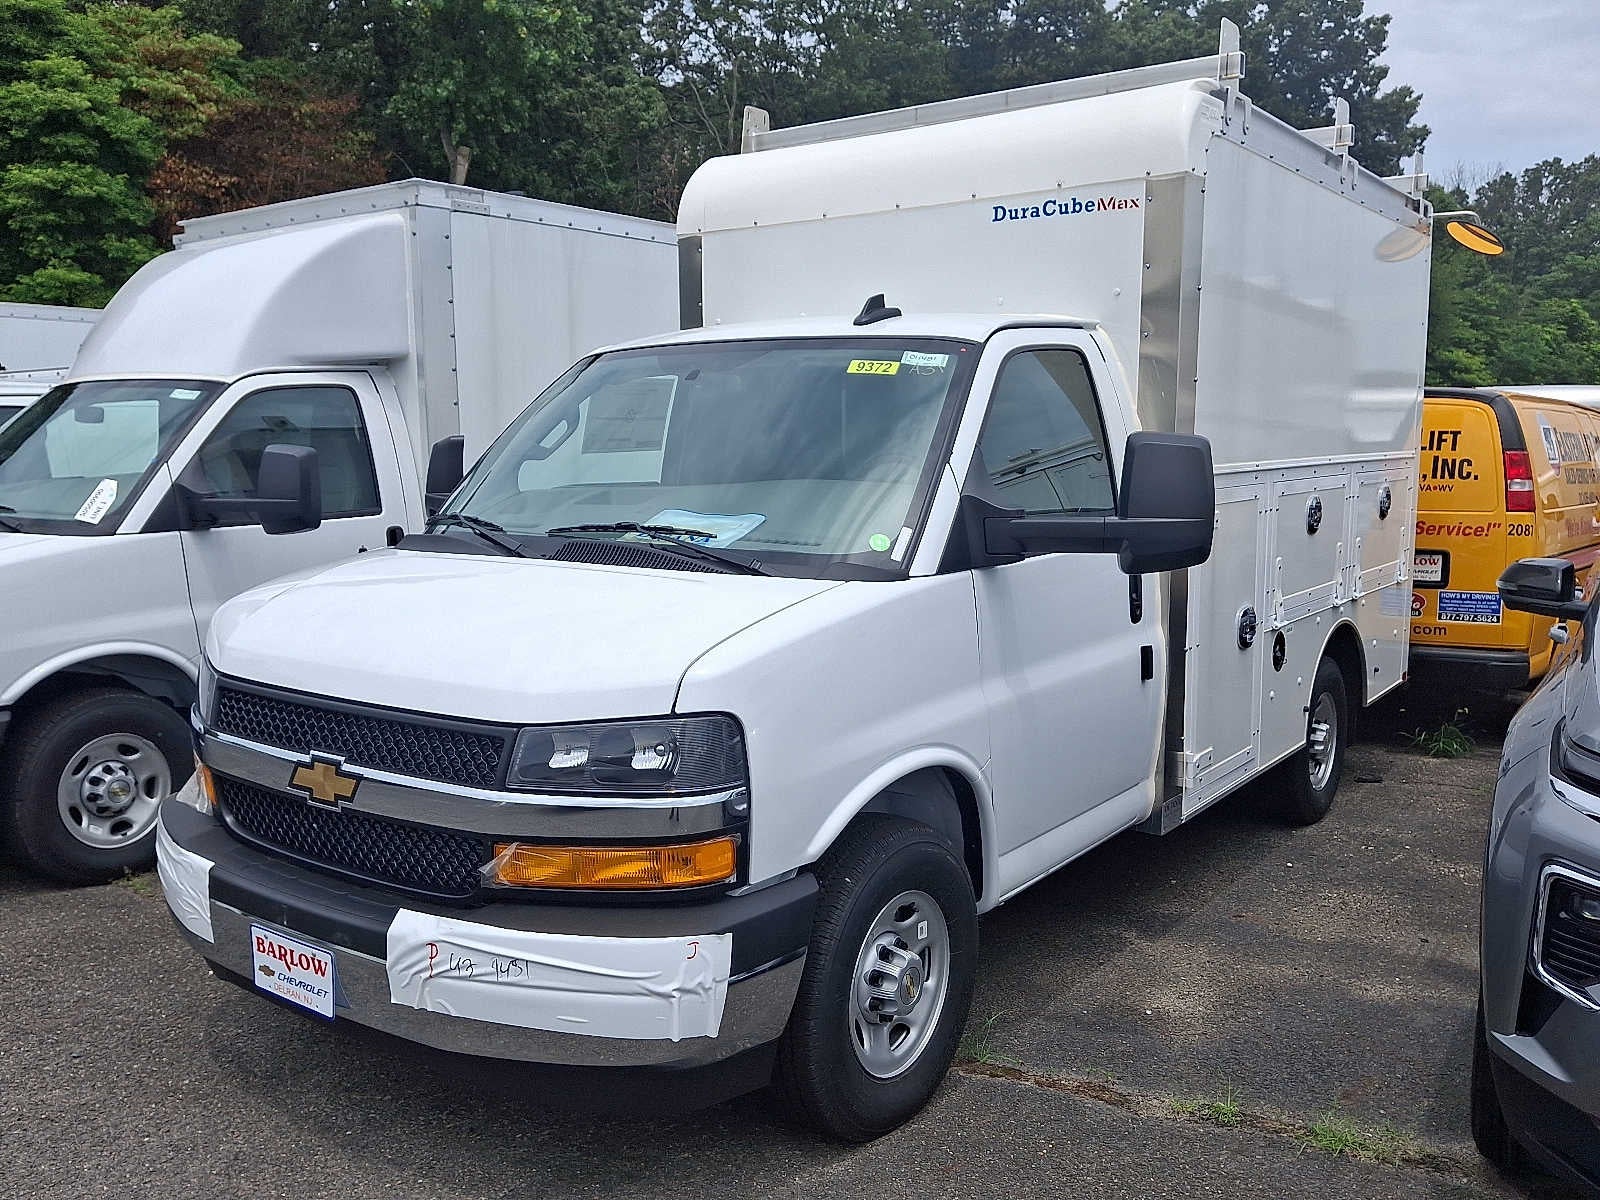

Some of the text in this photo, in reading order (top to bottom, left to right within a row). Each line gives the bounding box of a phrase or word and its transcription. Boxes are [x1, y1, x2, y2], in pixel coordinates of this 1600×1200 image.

[992, 197, 1139, 222] DuraCubeMax
[856, 361, 893, 373] 9372
[255, 936, 328, 978] BARLOW
[277, 972, 329, 999] CHEVROLET
